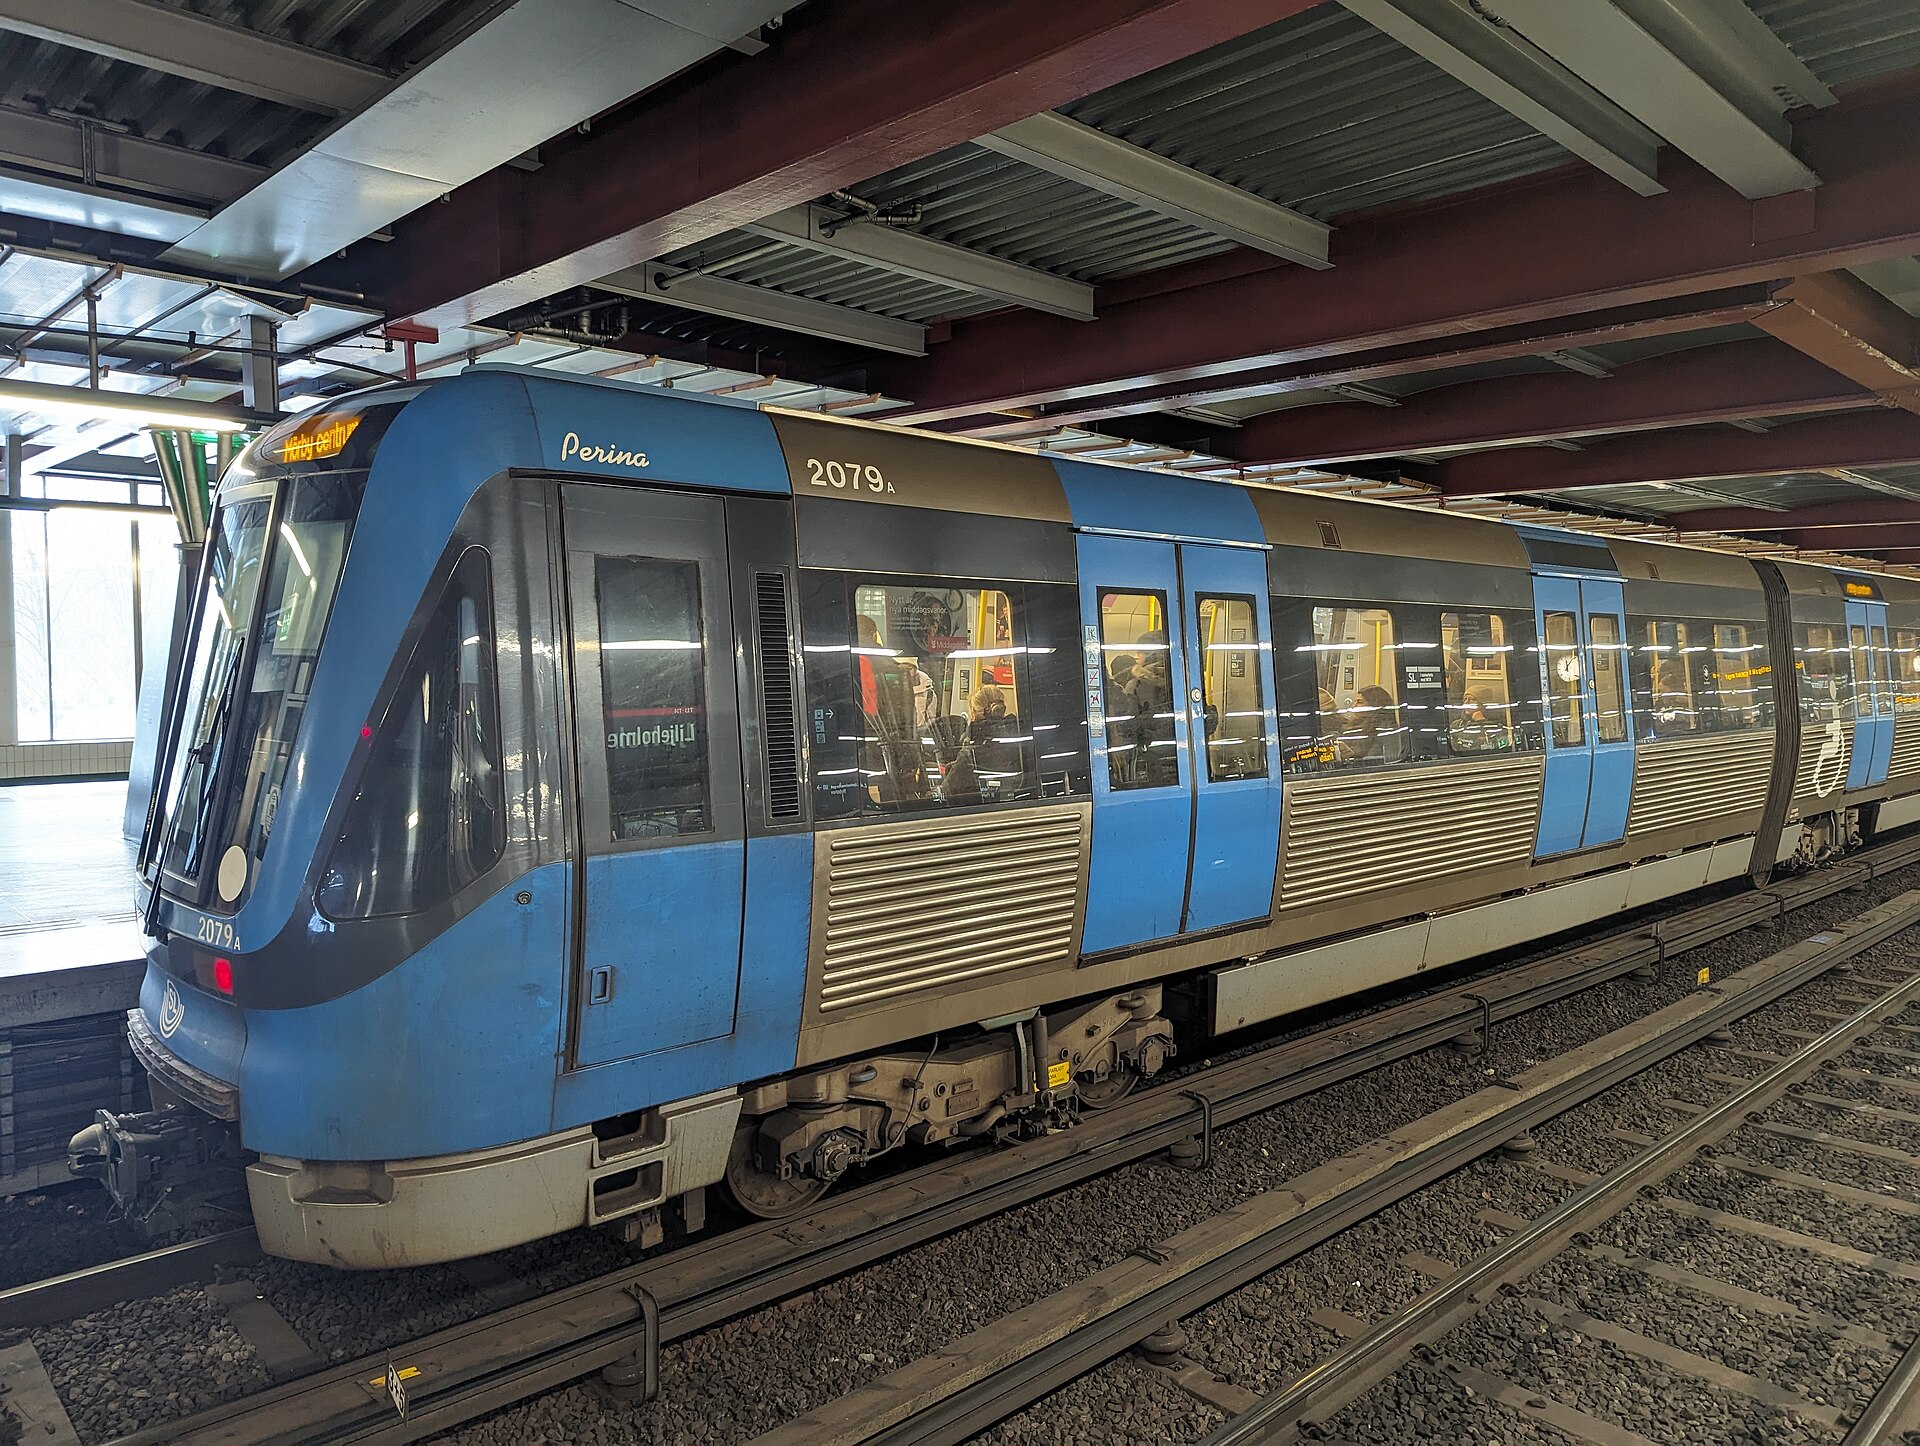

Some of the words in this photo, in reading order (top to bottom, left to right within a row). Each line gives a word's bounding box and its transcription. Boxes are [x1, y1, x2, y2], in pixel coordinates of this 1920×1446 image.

[284, 434, 313, 463] Mörby
[561, 432, 650, 468] Perina
[1408, 672, 1417, 682] SL
[168, 987, 178, 1014] SL
